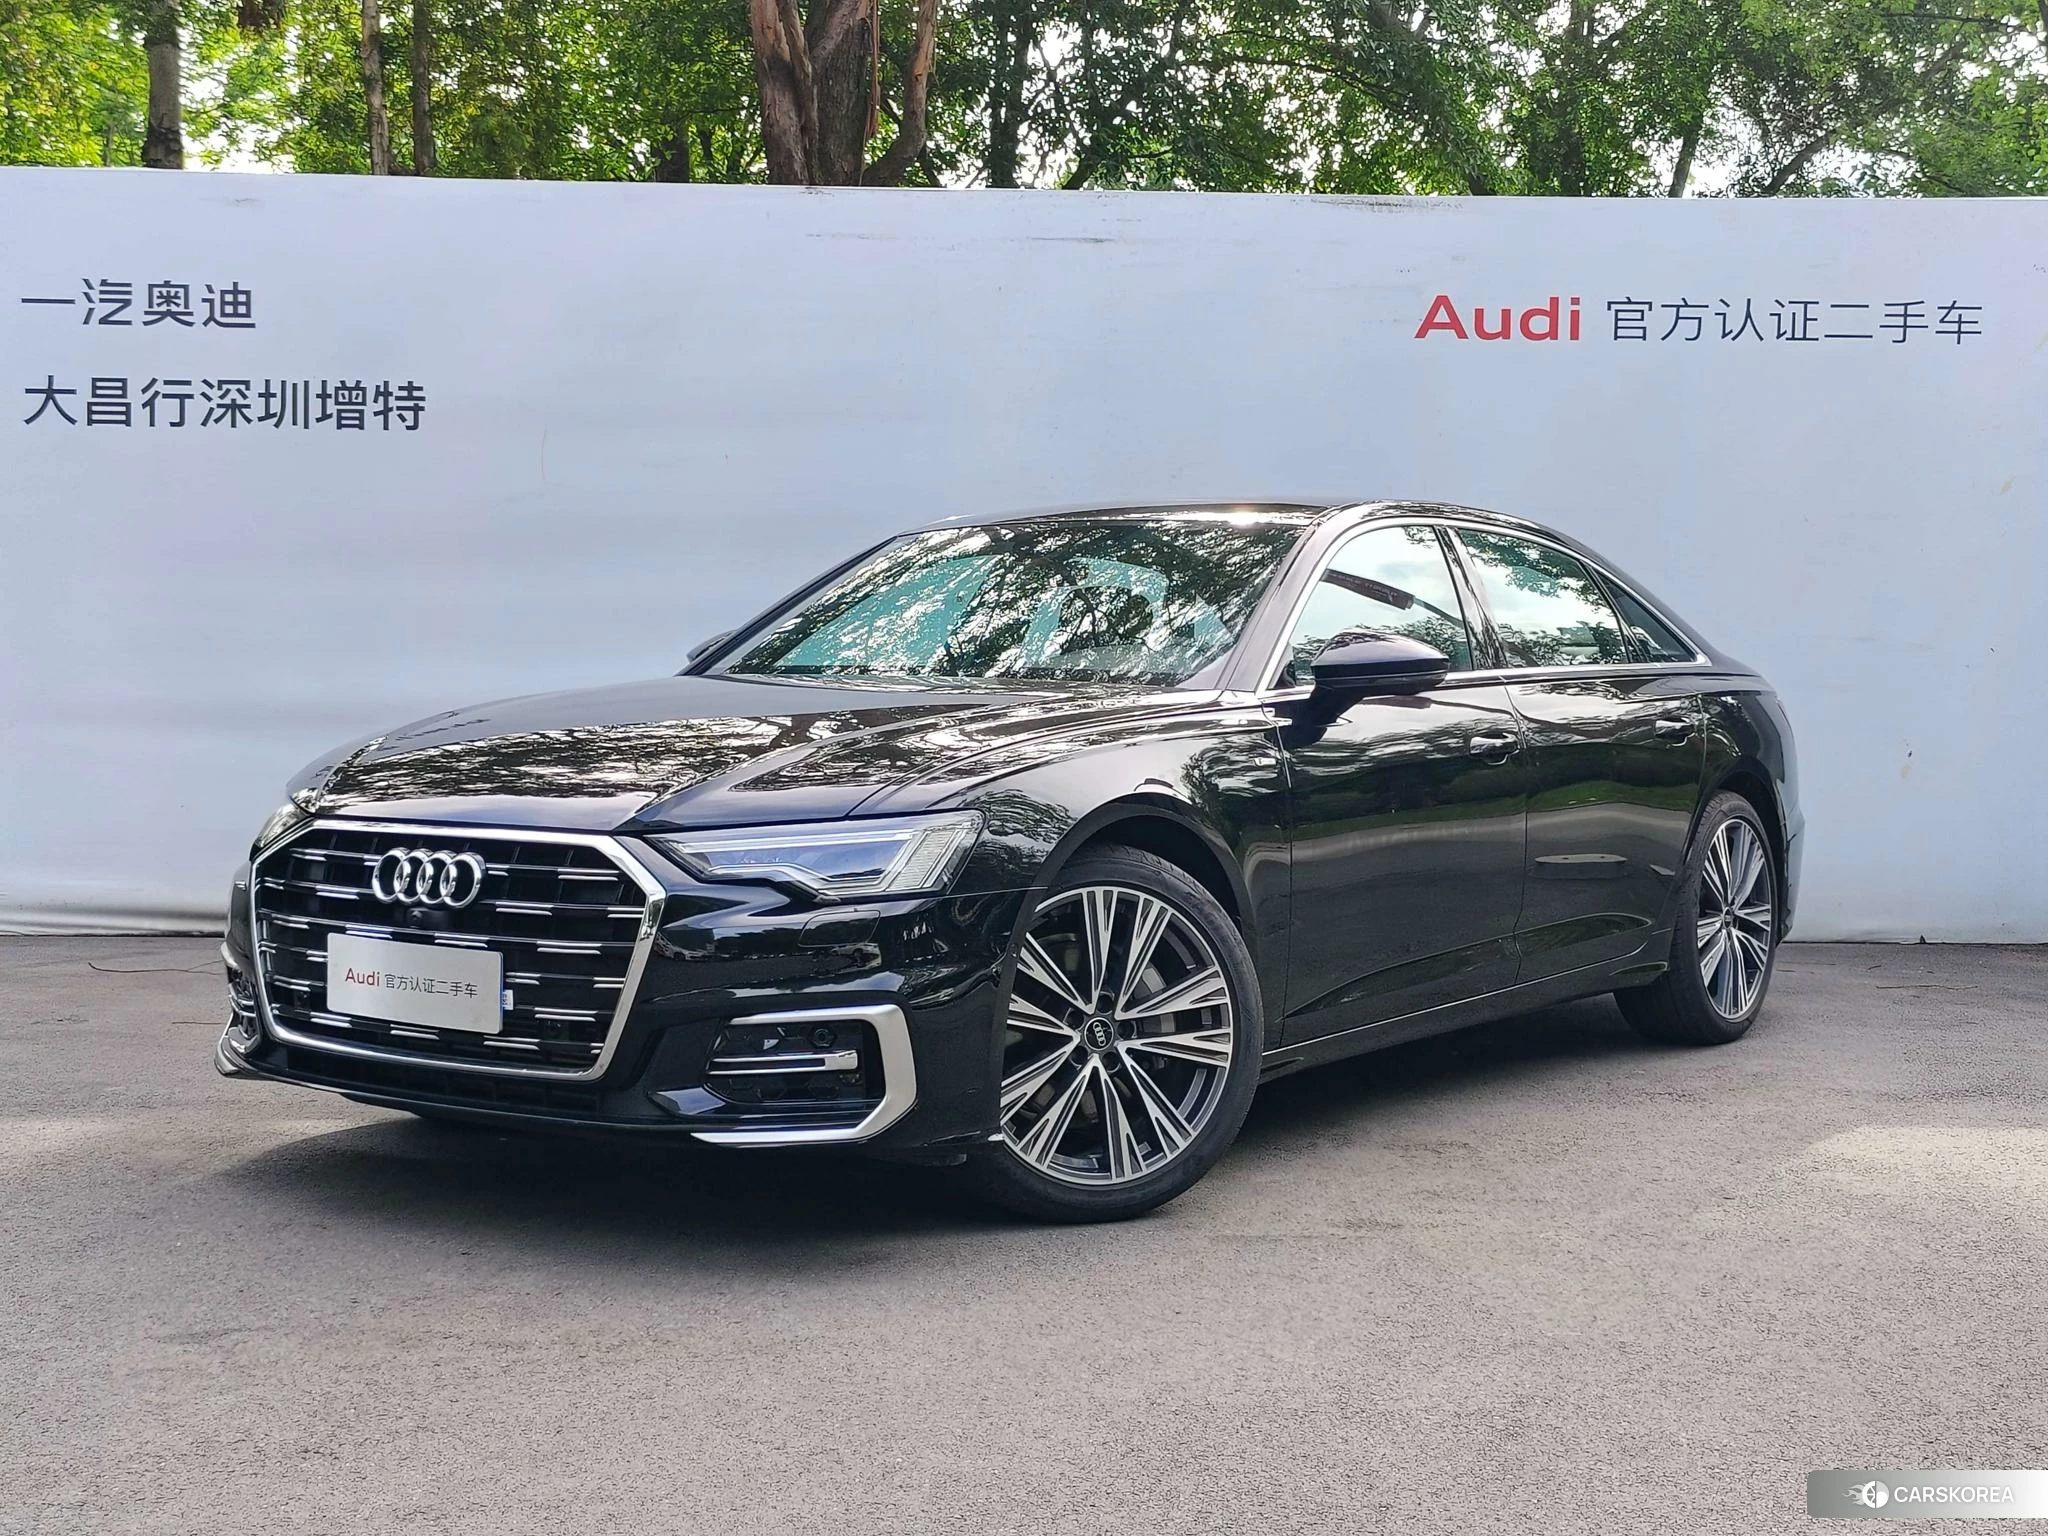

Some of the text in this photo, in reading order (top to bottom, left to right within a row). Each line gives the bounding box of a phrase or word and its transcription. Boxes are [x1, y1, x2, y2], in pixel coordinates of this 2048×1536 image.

[21, 278, 256, 329] 一汽奥迪
[1415, 294, 1984, 345] Audi 官方认证二手车
[23, 375, 427, 431] 大昌行深圳增特
[345, 968, 478, 998] Audi 官方认证二手车
